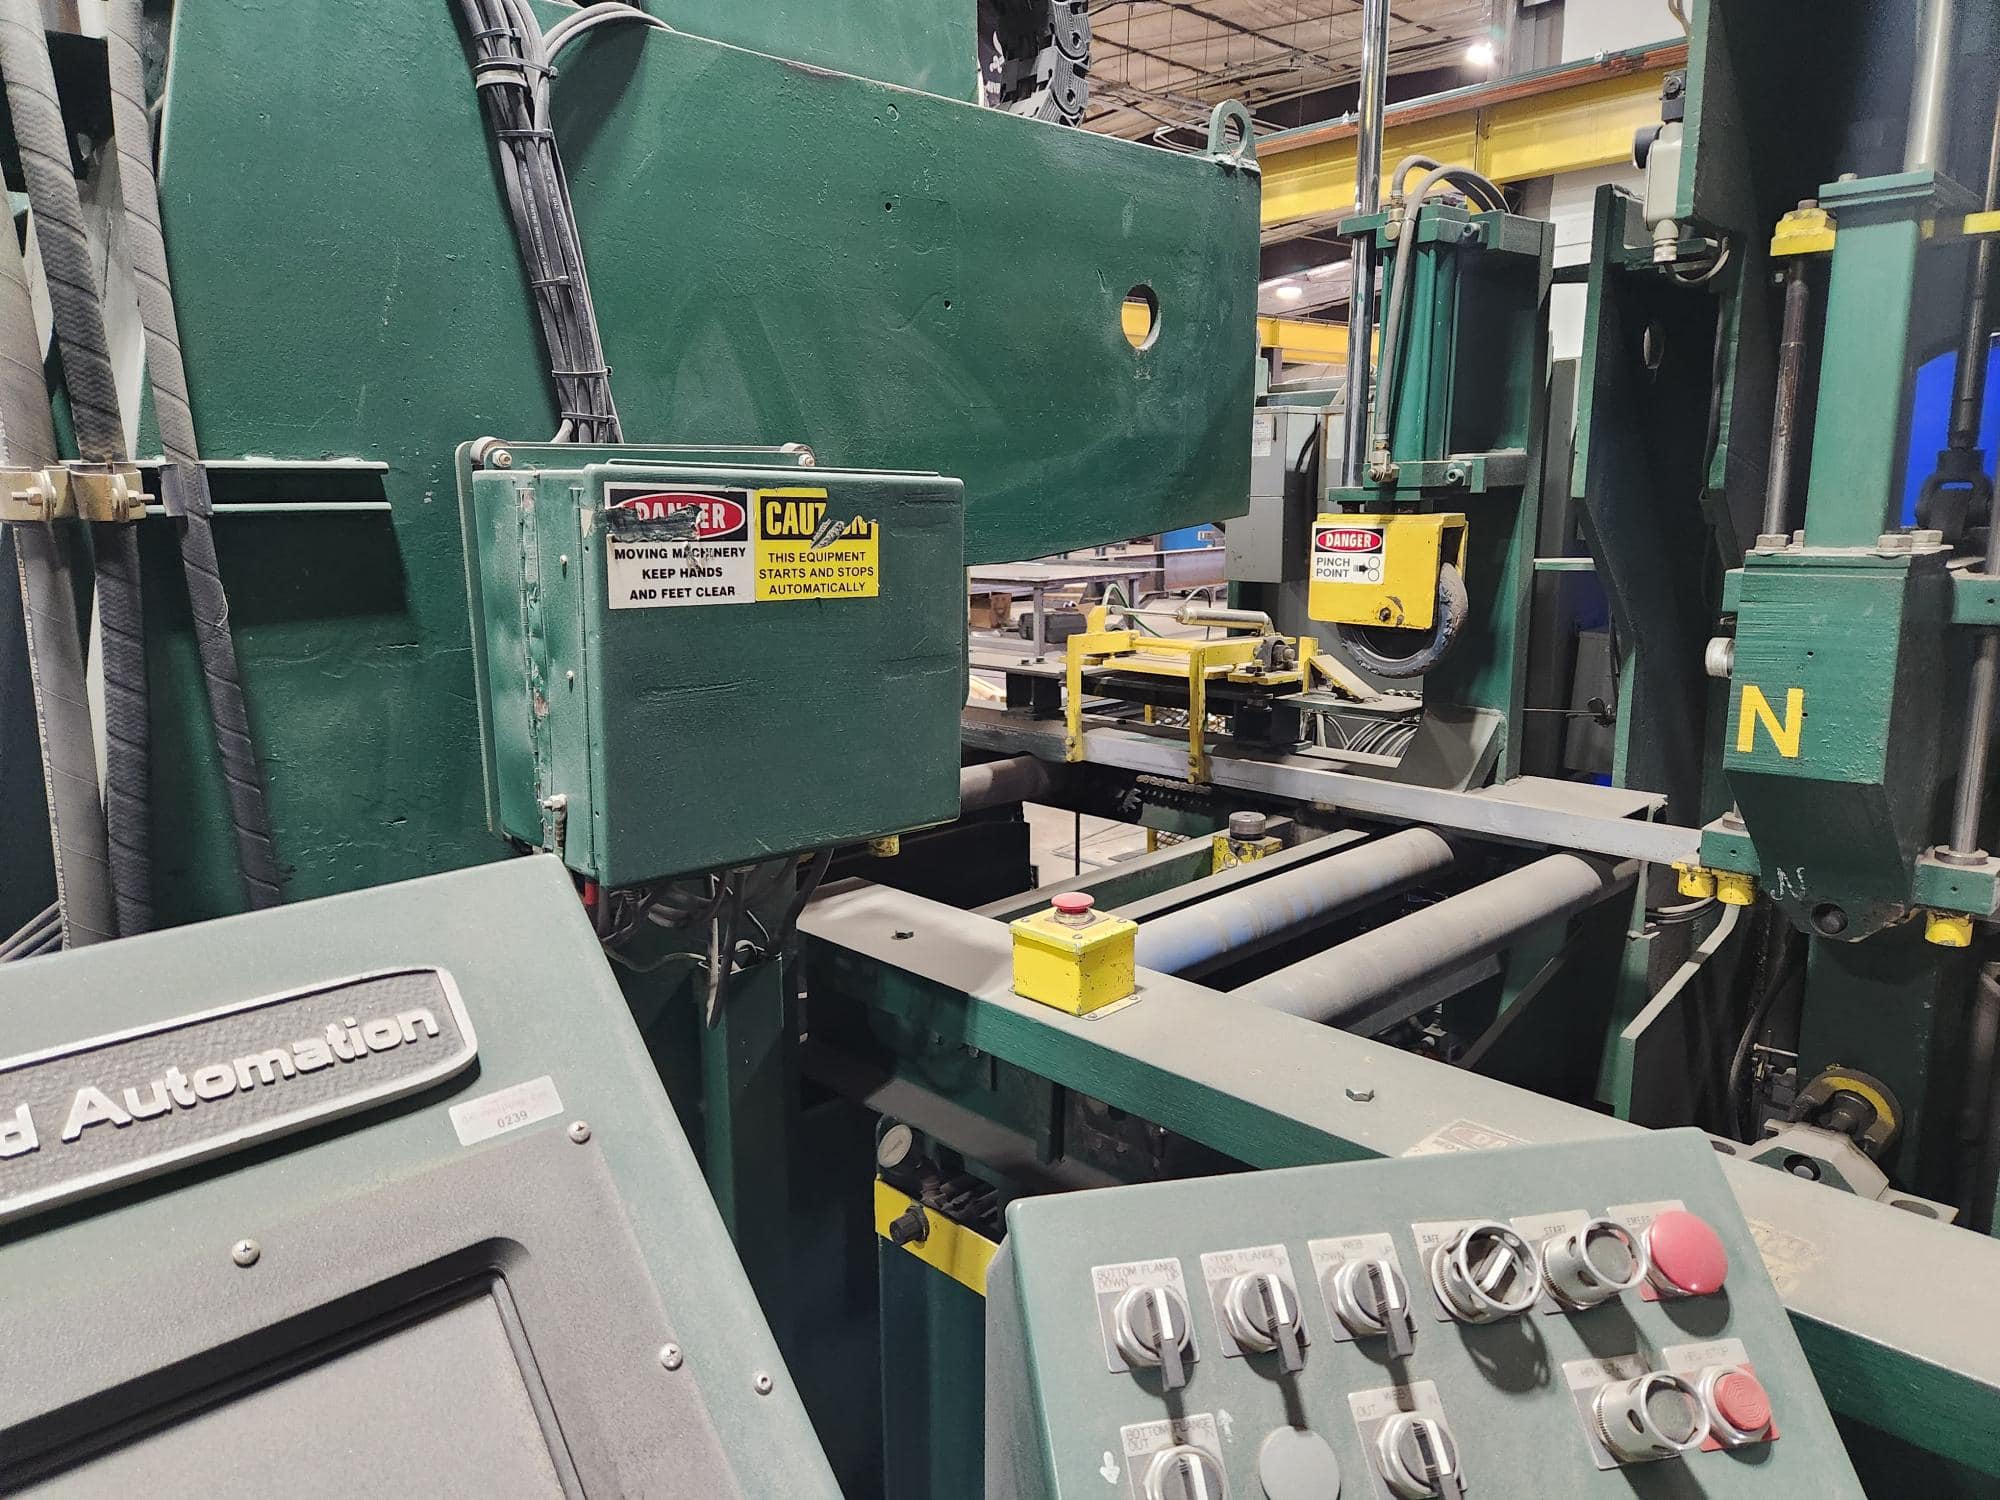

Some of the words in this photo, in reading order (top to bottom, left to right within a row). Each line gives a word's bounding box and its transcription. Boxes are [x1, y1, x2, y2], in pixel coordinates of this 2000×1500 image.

[766, 502, 868, 535] CAUTN
[1326, 533, 1371, 548] DANGER
[614, 549, 668, 560] MOVING
[768, 553, 796, 563] THIS
[799, 552, 866, 563] EQUIPMENT
[1316, 557, 1350, 567] PINCH
[642, 569, 676, 580] KEEP
[679, 567, 723, 578] HANDS
[759, 568, 806, 579] STARTS
[809, 568, 834, 578] AND
[837, 566, 874, 577] STOPS
[1316, 568, 1350, 578] POINT
[630, 590, 657, 601] AND
[661, 588, 692, 599] FEET
[696, 586, 736, 597] CLEAR
[769, 582, 866, 595] AUTOMATICALLY
[1737, 685, 1804, 758] N
[61, 1008, 440, 1143] Automation
[497, 1110, 529, 1129] 0239
[1422, 1234, 1440, 1244] SAFE
